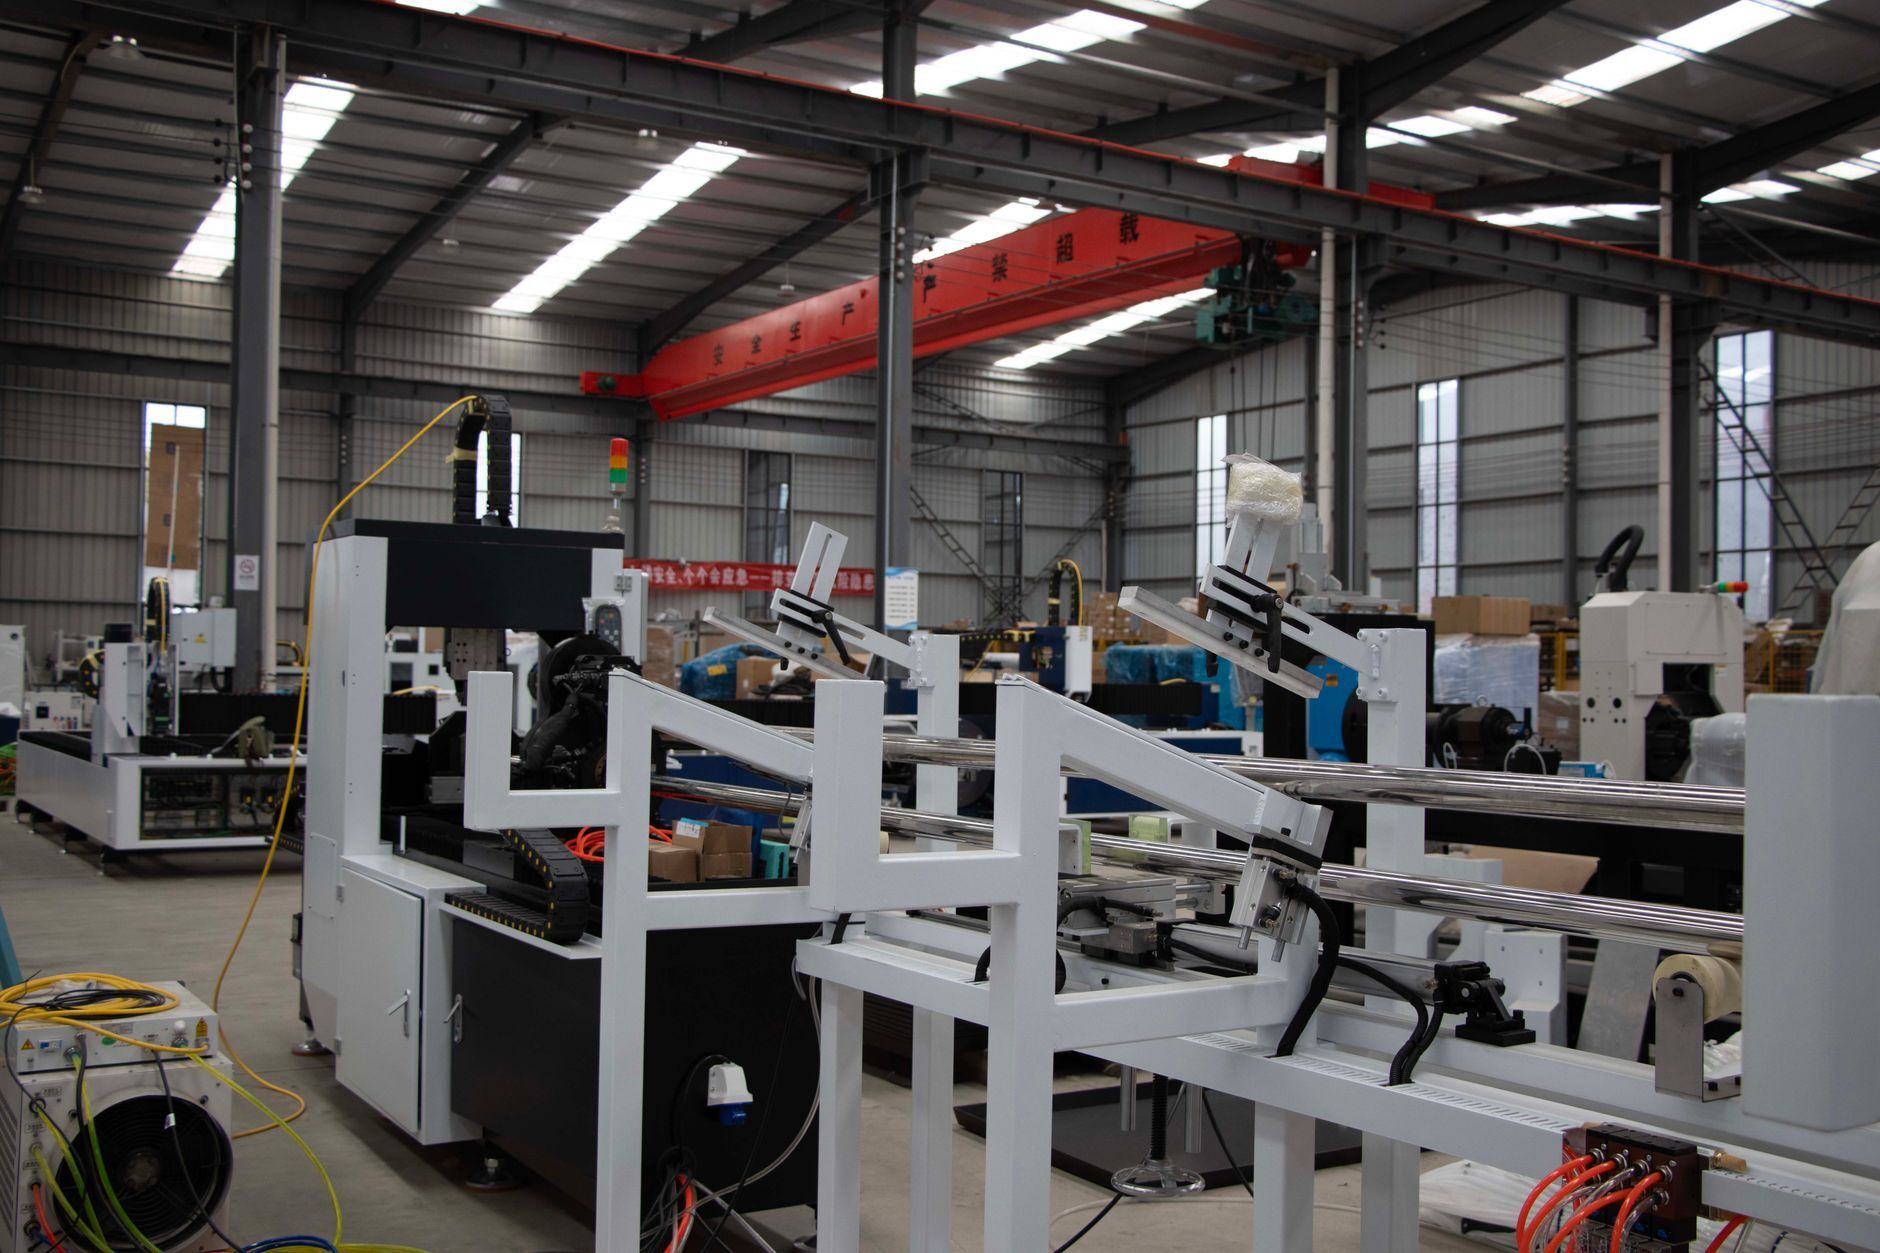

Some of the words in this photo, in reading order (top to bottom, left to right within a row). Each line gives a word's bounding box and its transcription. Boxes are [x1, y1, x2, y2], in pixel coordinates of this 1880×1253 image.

[713, 302, 854, 366] 安全生产
[923, 213, 1139, 304] 严禁超载
